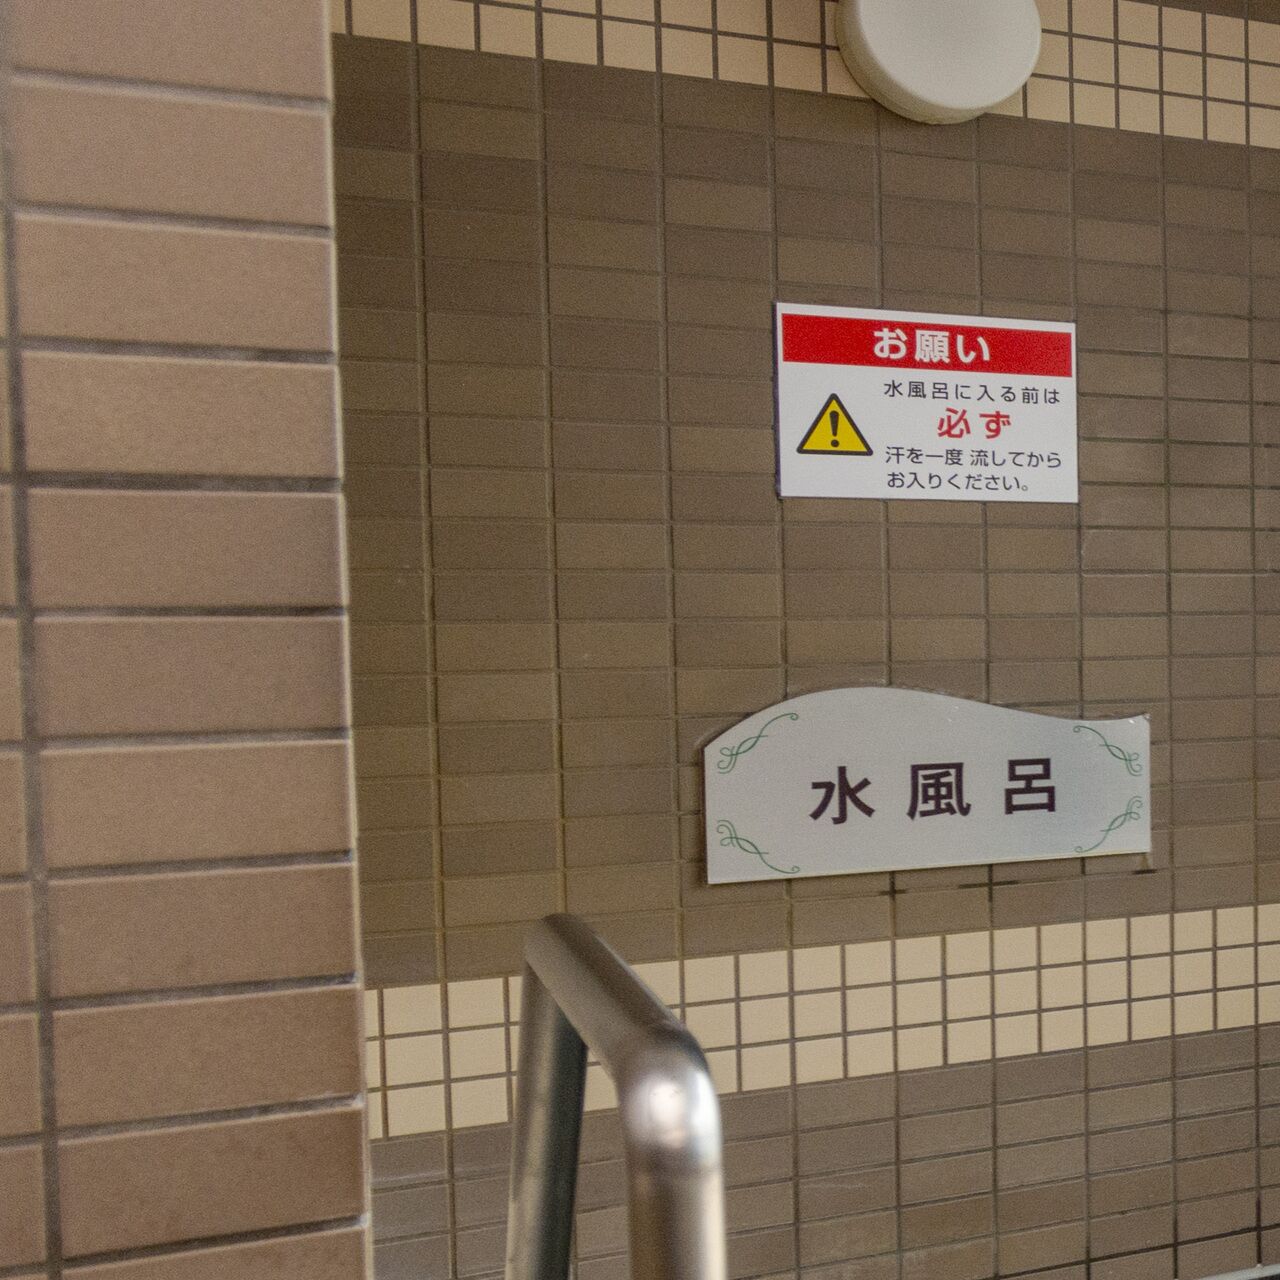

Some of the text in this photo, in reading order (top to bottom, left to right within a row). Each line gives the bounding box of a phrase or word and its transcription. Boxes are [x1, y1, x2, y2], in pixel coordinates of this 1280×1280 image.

[873, 329, 990, 364] お願い
[884, 380, 1061, 404] 水風呂に入る前は
[937, 407, 1011, 439] 必ず
[887, 472, 1030, 491] お入りください。
[809, 758, 1056, 824] 水風呂
